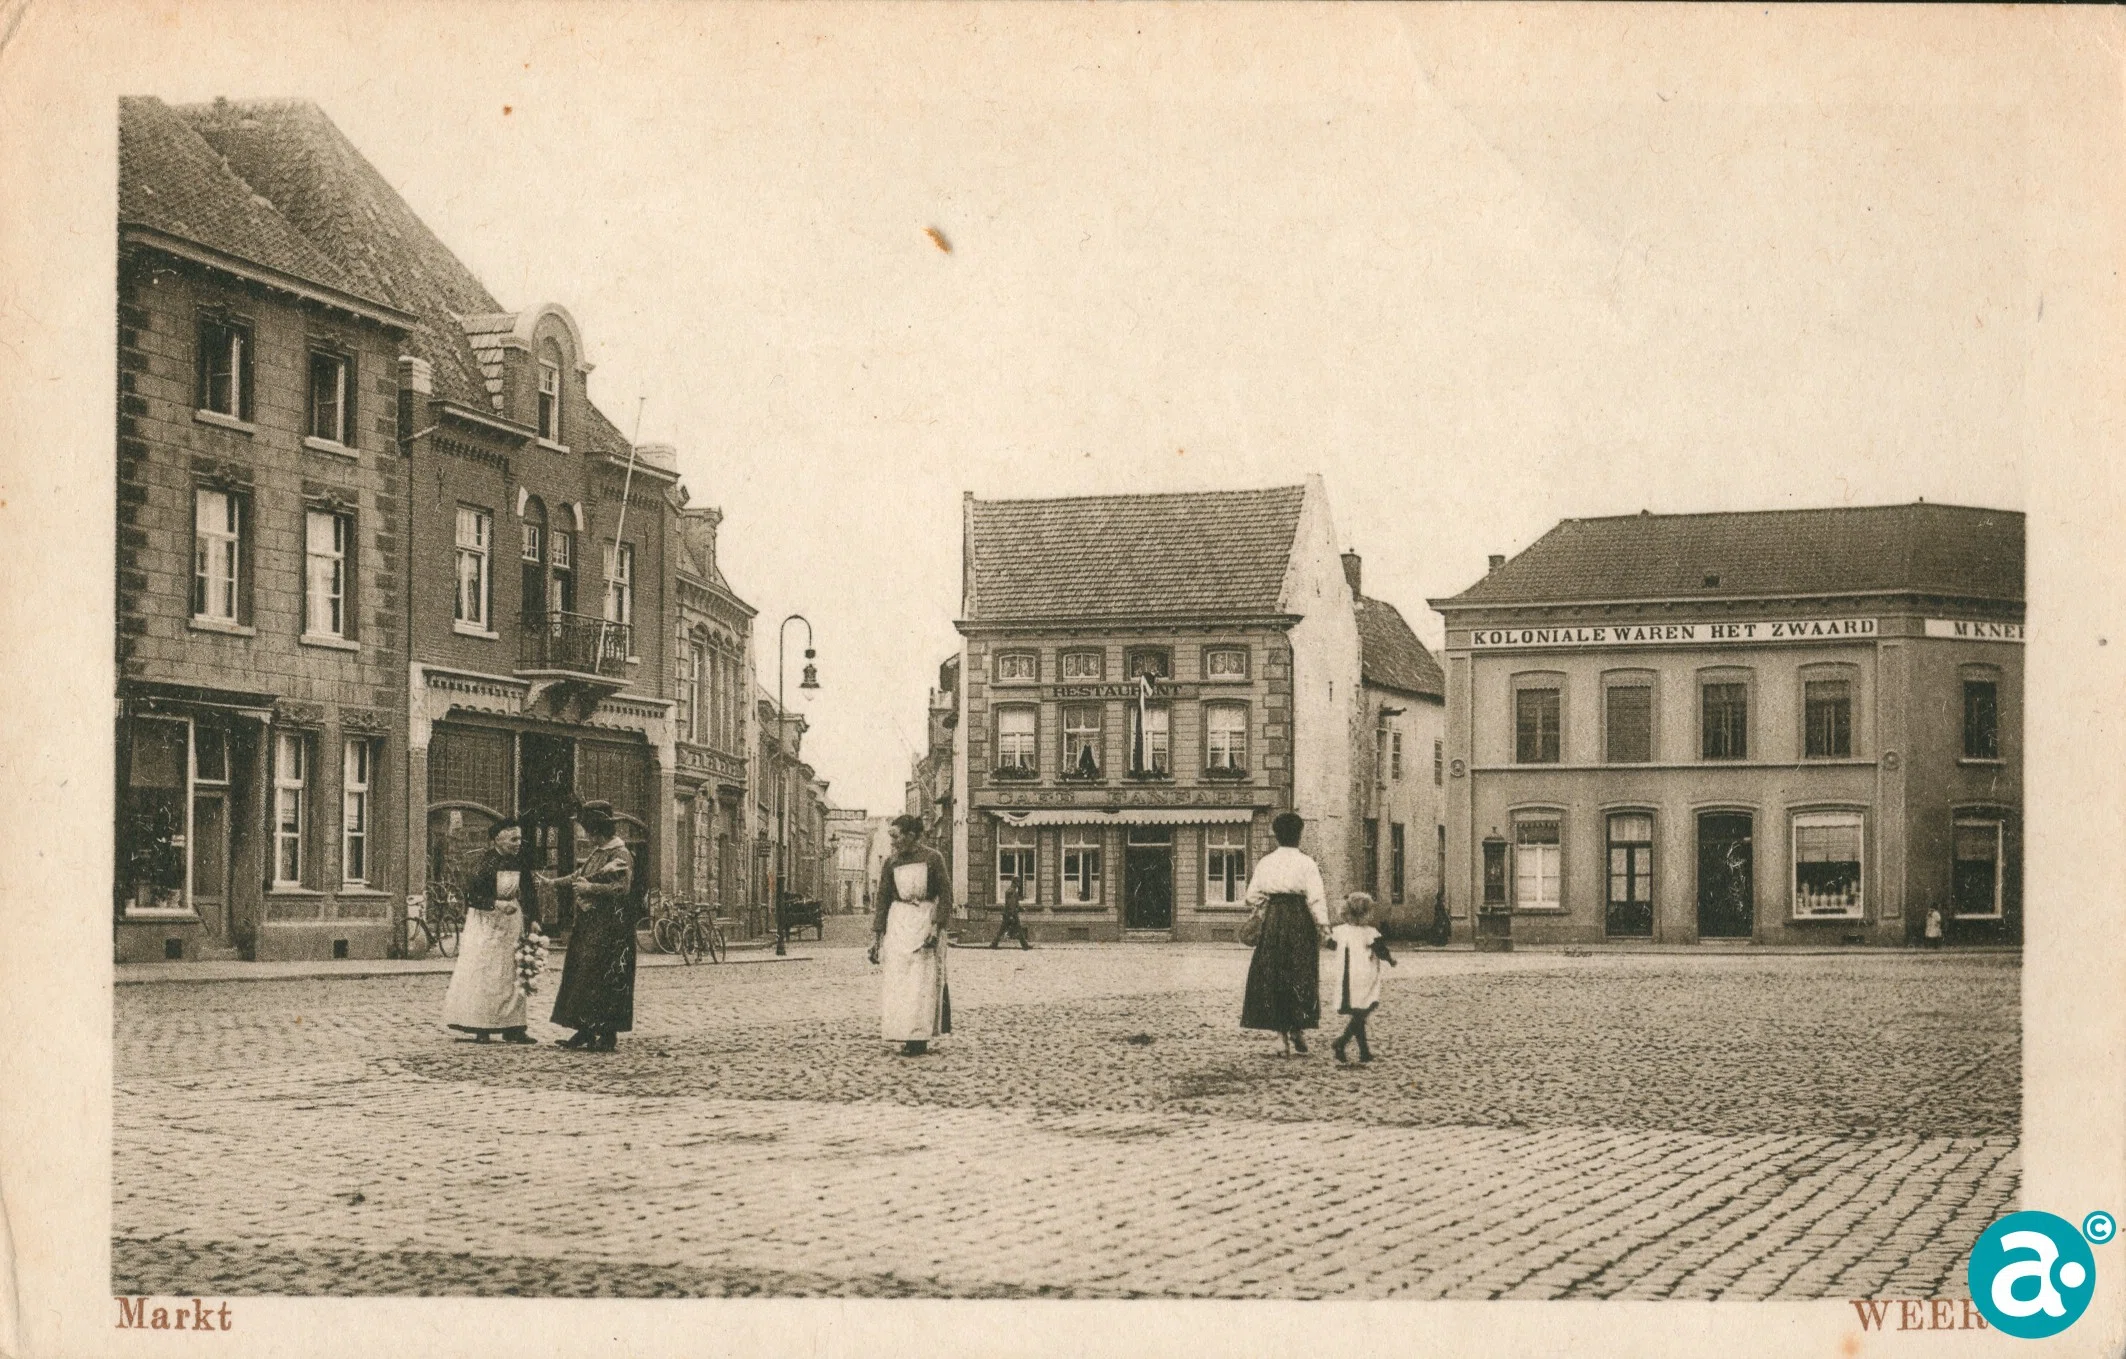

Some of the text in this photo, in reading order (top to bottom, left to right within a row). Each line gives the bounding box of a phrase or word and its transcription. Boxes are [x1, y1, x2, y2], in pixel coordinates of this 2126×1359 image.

[1474, 620, 1875, 645] KOLONIALE WAREN HET ZWAARD
